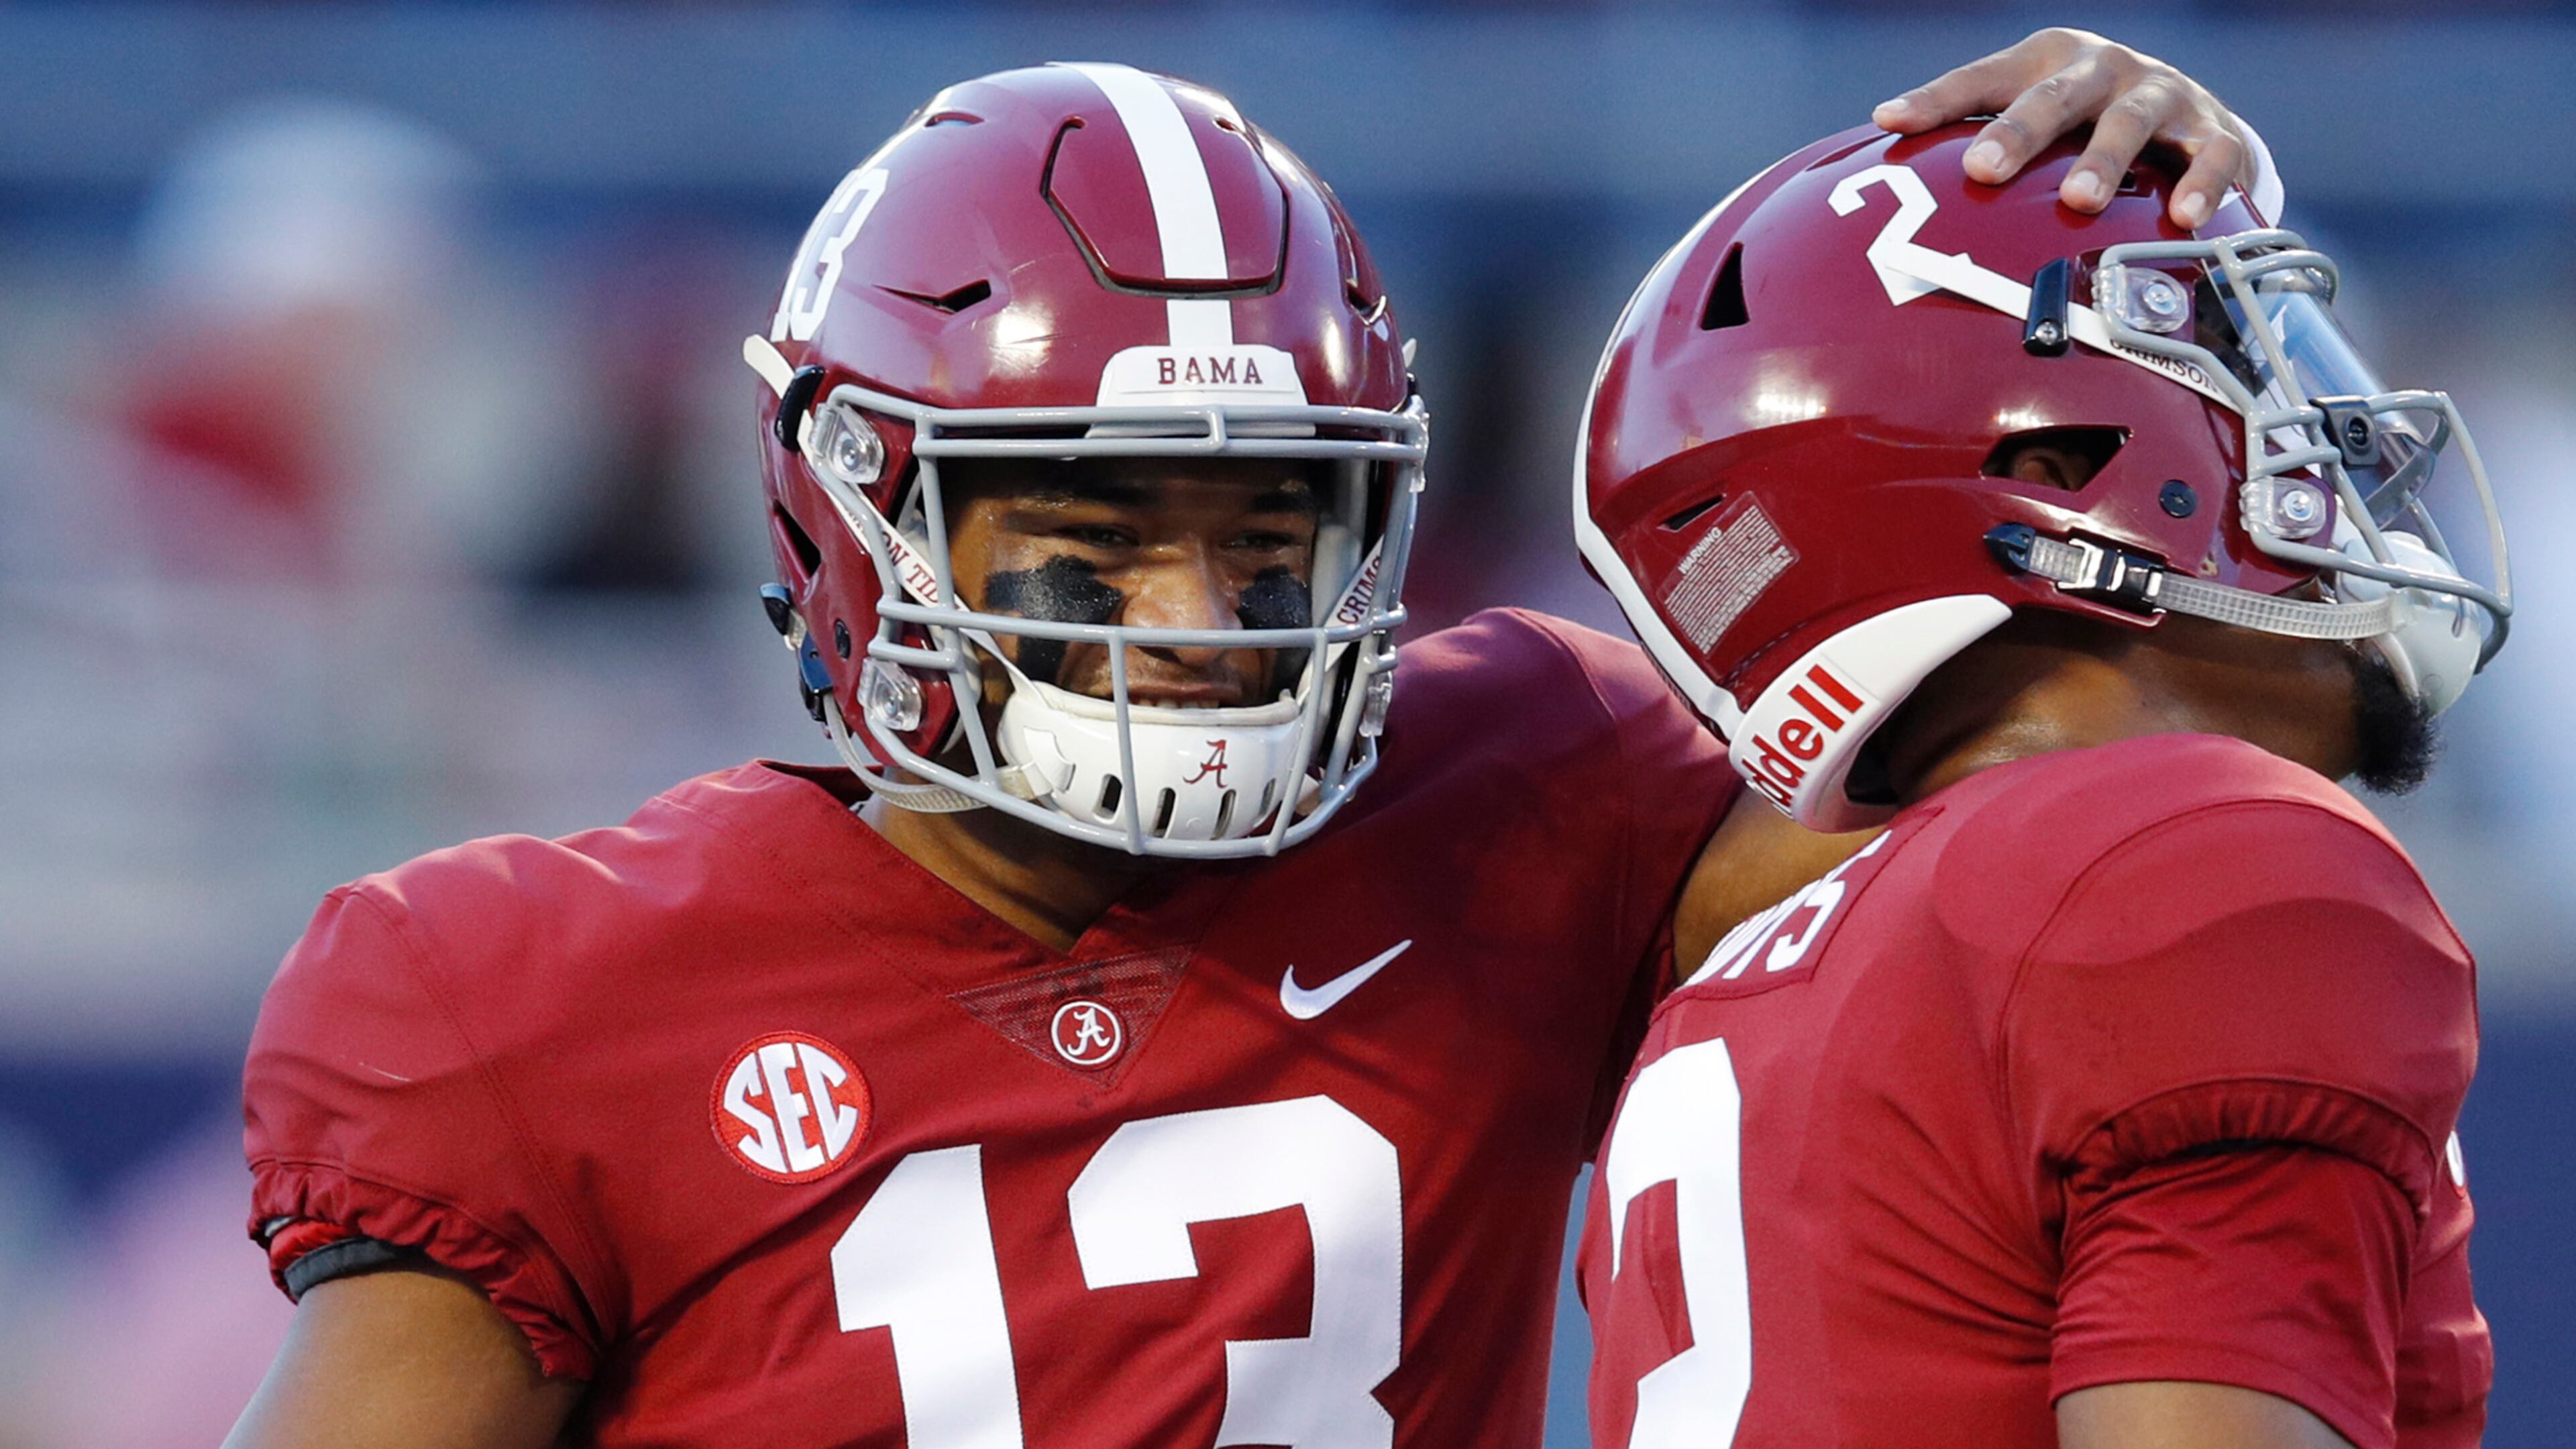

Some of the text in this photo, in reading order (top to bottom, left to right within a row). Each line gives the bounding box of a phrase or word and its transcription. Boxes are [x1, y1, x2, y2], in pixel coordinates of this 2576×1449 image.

[1827, 164, 1974, 306] 2
[1157, 356, 1263, 385] BAMA
[1678, 527, 1723, 574] WARNING
[906, 563, 947, 604] TI
[1740, 663, 1865, 810] ddell
[1182, 739, 1228, 789] A
[1067, 1006, 1111, 1056] A
[723, 1042, 859, 1174] SEC
[830, 1093, 1403, 1449] 13
